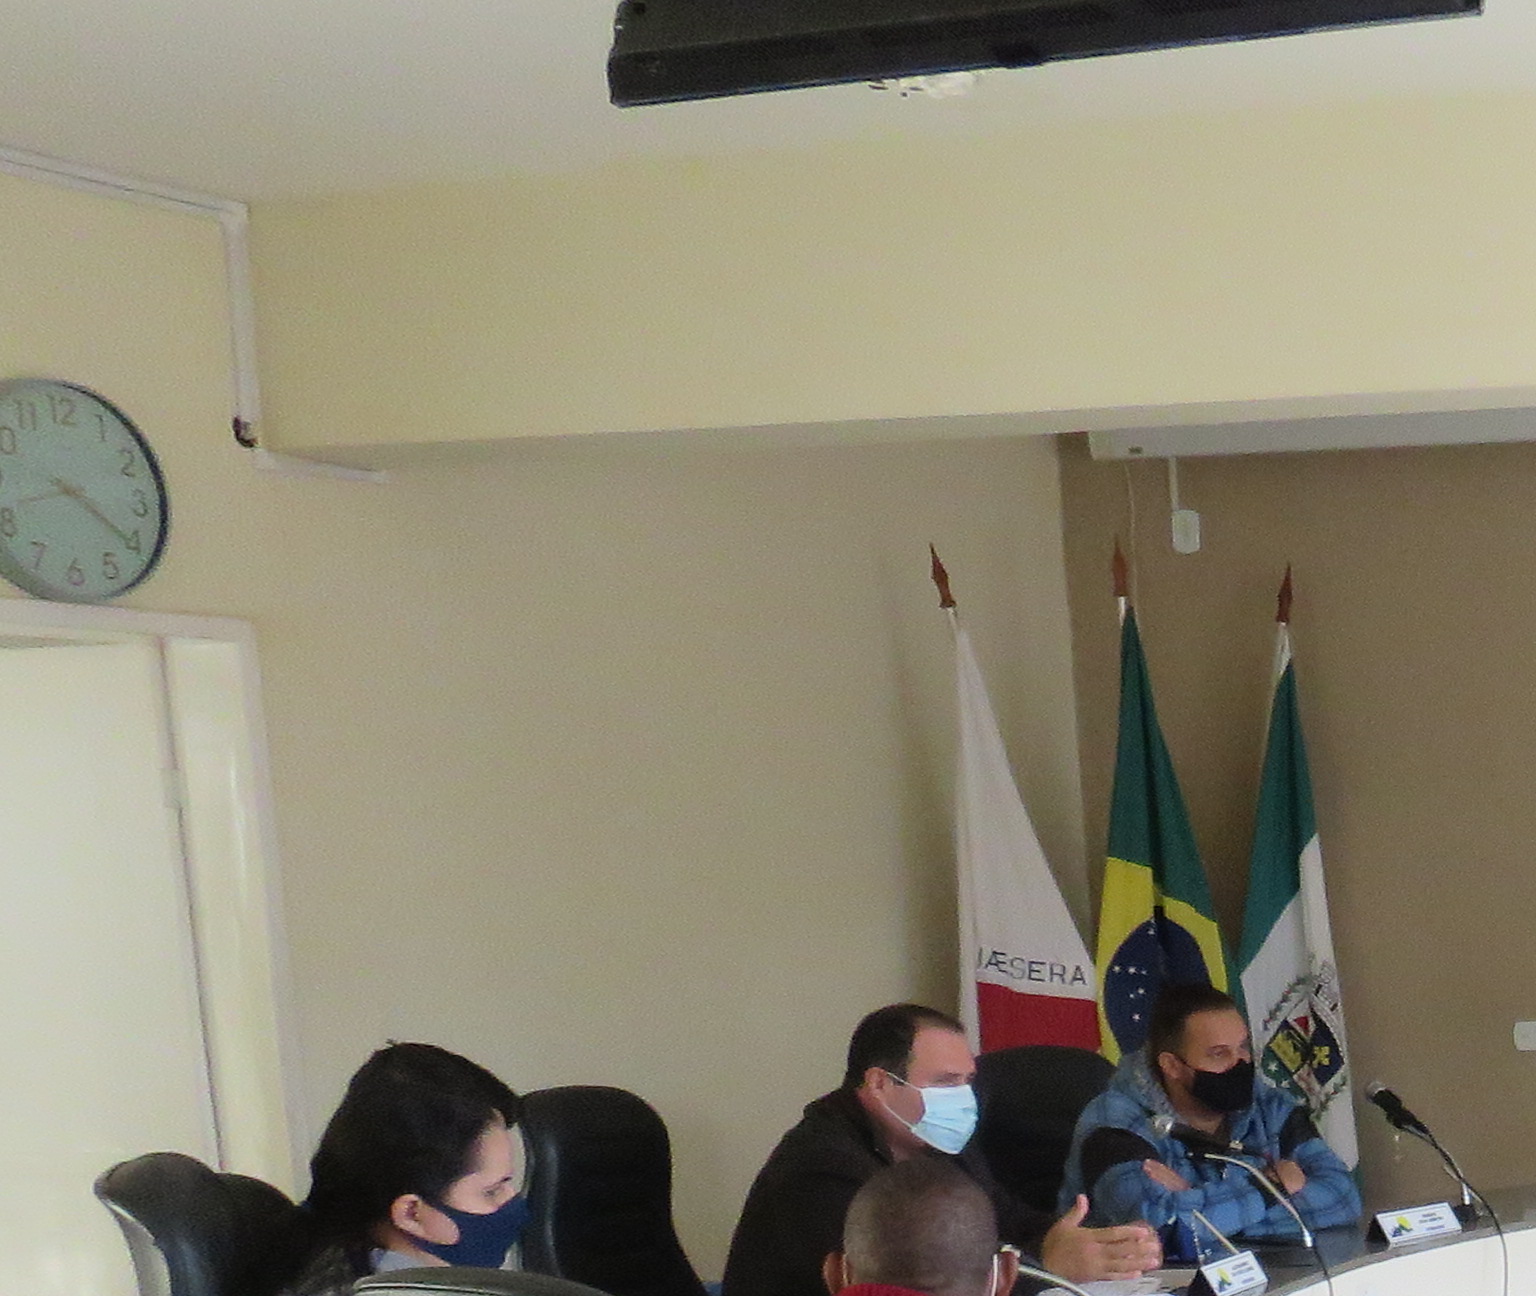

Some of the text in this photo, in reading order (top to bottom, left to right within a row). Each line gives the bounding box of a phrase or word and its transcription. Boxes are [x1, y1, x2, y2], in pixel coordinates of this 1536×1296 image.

[13, 400, 37, 430] 11
[48, 395, 77, 427] 12
[0, 426, 17, 455] 0
[94, 413, 106, 442] 1
[119, 449, 138, 479] 2
[131, 488, 149, 519] 3
[30, 540, 47, 570] 7
[101, 551, 120, 580] 5
[66, 557, 86, 587] 6
